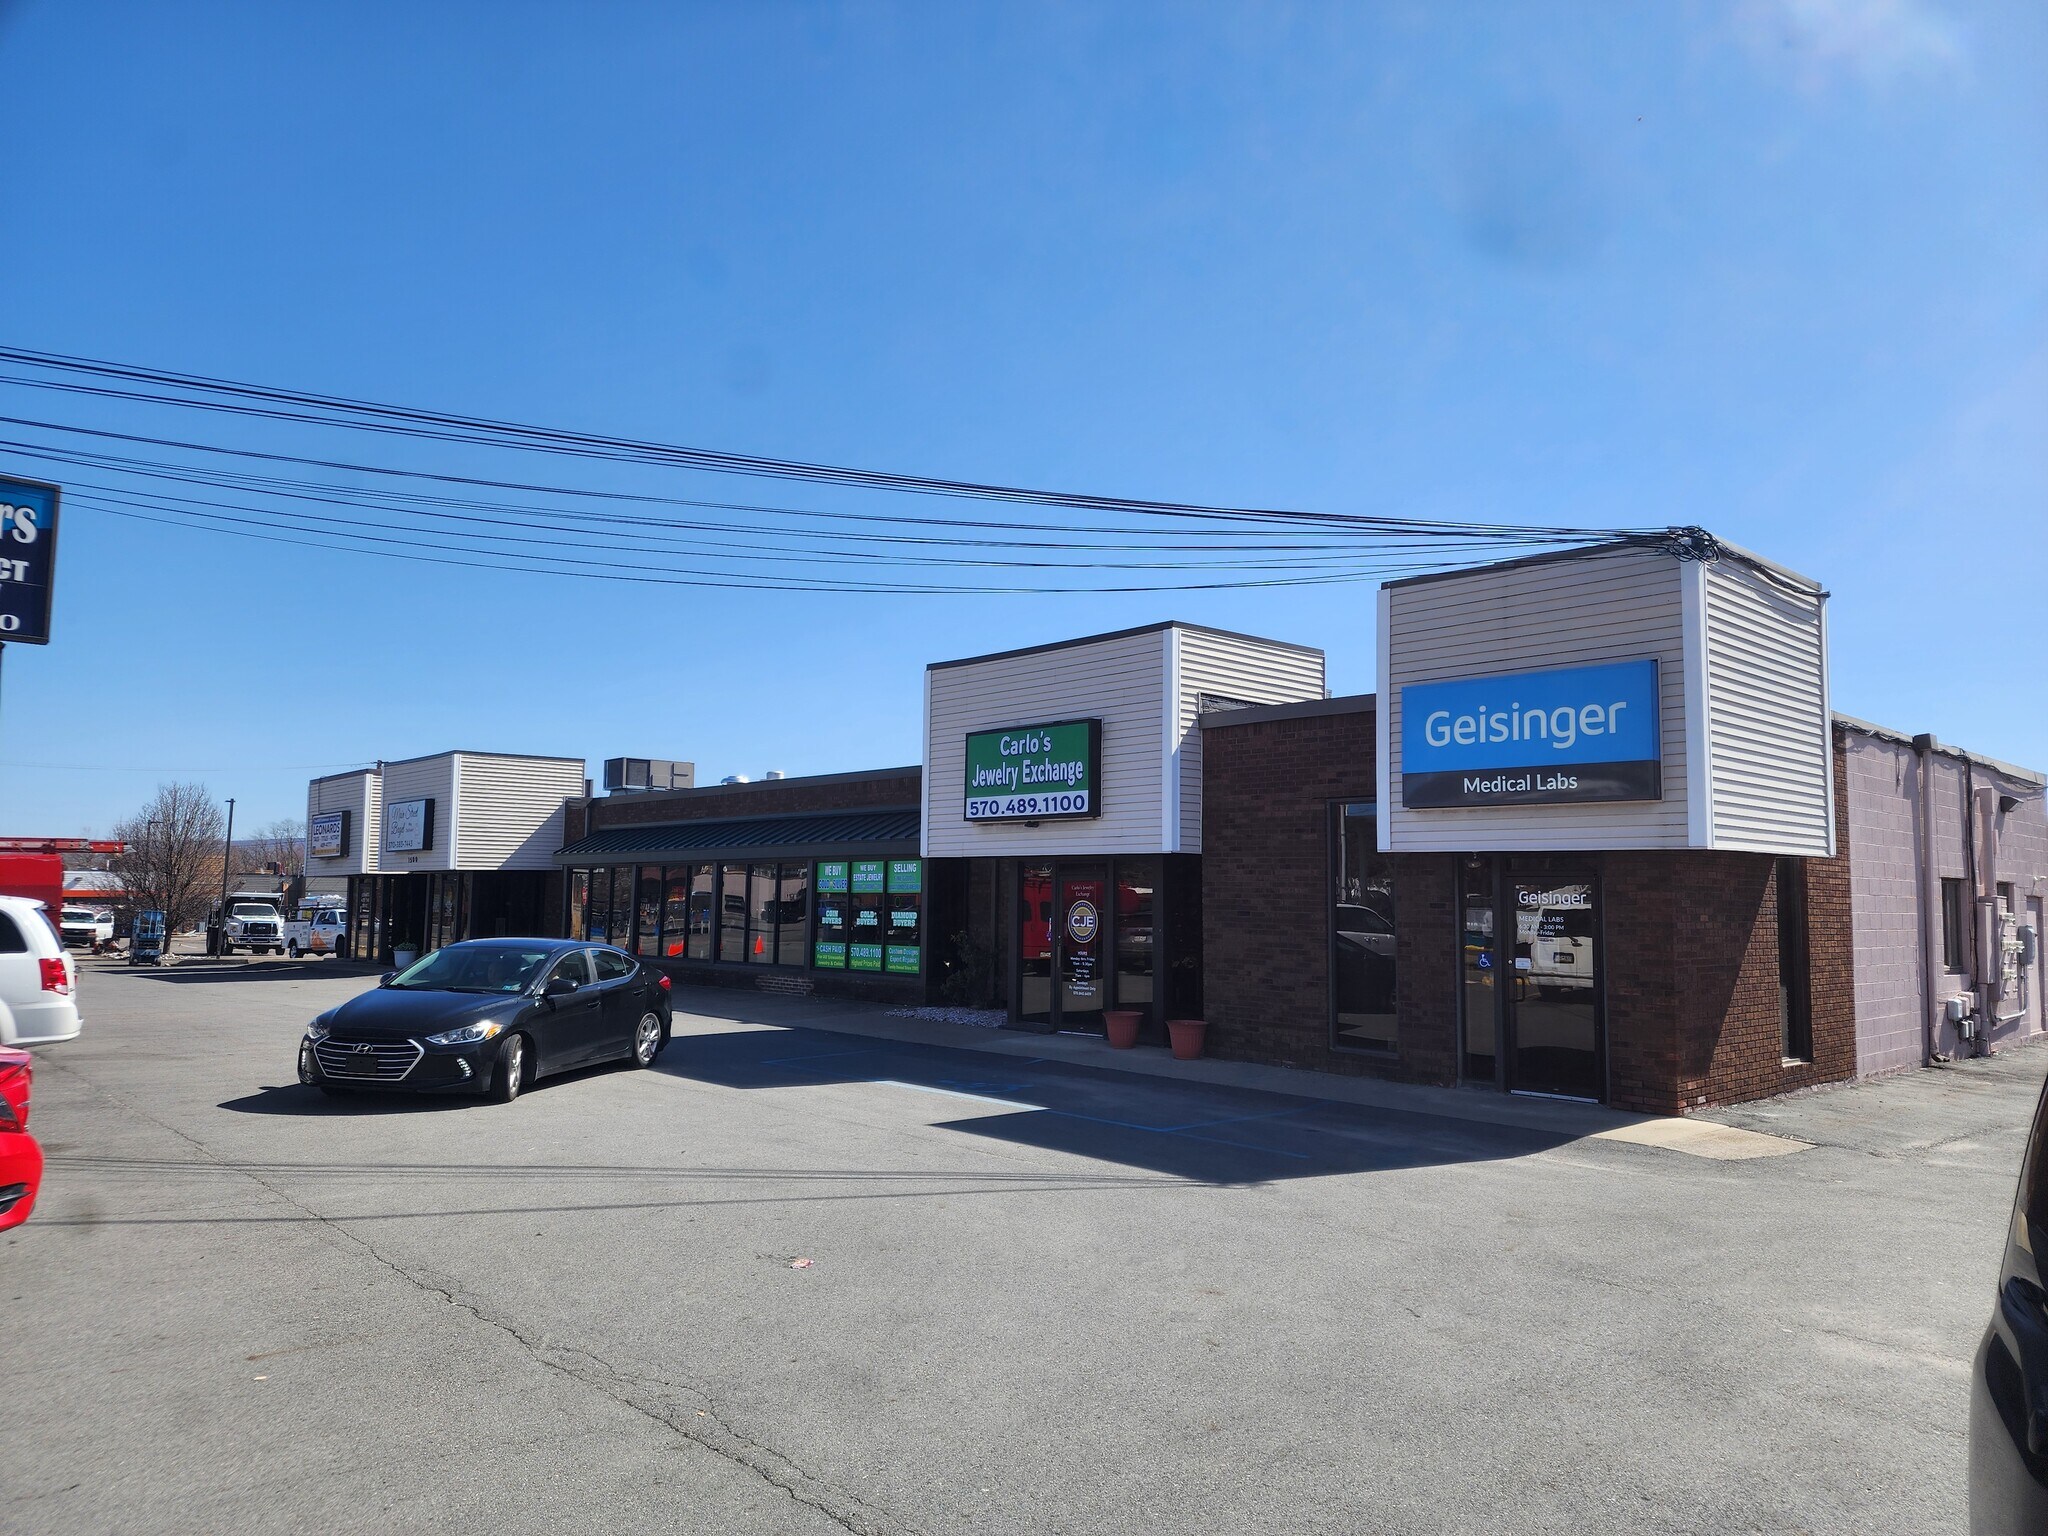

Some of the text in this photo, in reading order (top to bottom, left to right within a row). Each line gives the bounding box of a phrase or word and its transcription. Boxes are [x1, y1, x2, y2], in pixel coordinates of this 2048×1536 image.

[1425, 702, 1627, 749] Geisinger
[1000, 731, 1052, 756] Carlo's
[972, 758, 1084, 791] Jewelry Exchange
[1463, 773, 1578, 794] Medical Labs
[970, 795, 1085, 816] 570.489.1100
[313, 823, 340, 835] LEONARDS
[824, 865, 842, 875] WE BUY
[894, 864, 917, 872] SELLING
[1518, 891, 1586, 907] Geisinger
[893, 919, 916, 927] BUYERS
[1071, 916, 1094, 927] CJE
[850, 947, 881, 958] 570.489.1100
